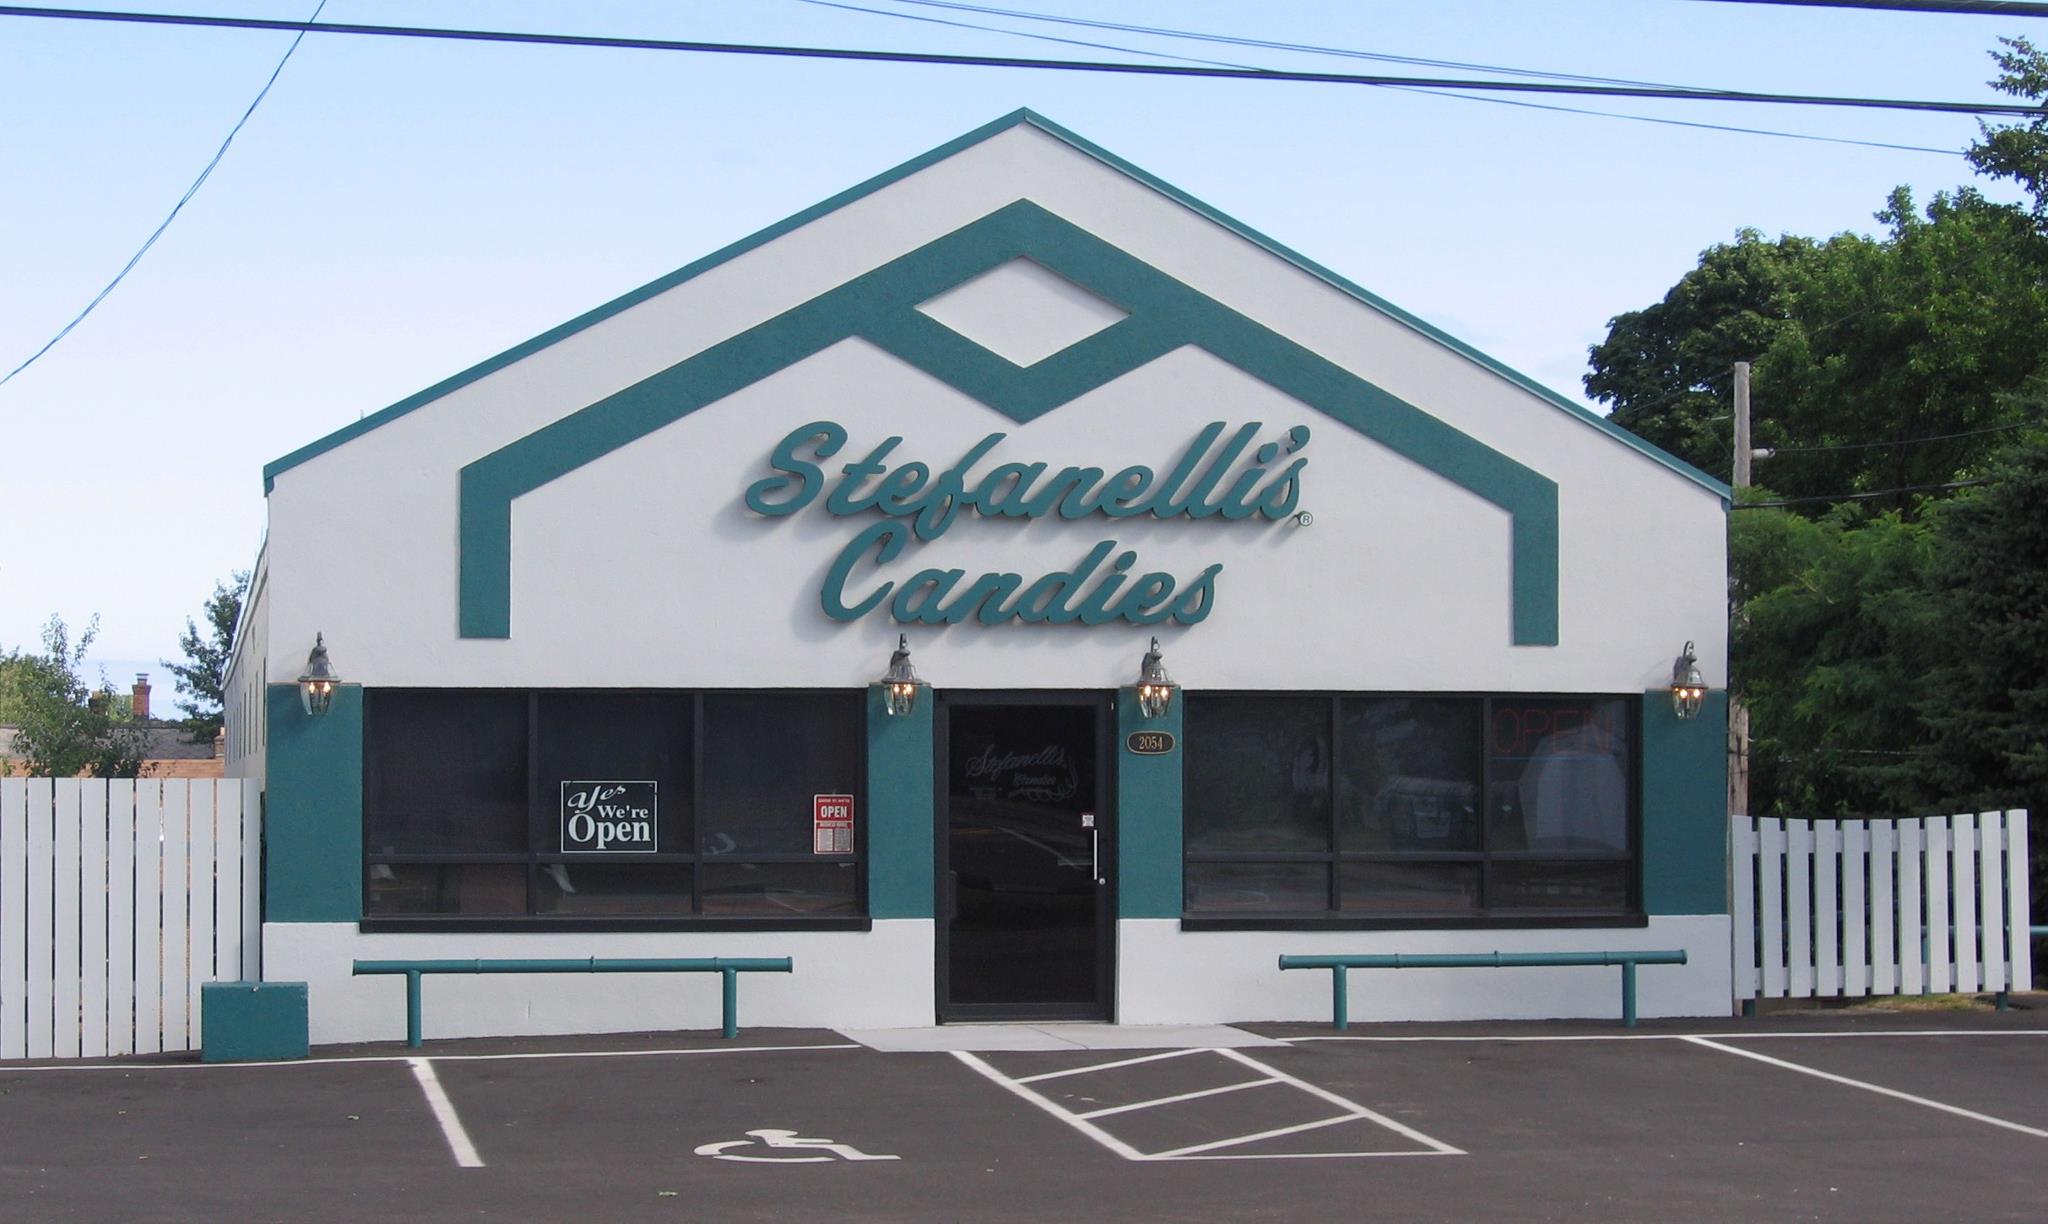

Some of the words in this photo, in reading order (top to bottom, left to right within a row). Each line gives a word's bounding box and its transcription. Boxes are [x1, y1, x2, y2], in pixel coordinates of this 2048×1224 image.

[745, 421, 1309, 541] Stefanelli's
[821, 520, 1222, 625] Candies
[1139, 736, 1163, 750] 2054
[1492, 707, 1612, 754] OPEN
[567, 785, 626, 814] Yes
[597, 805, 649, 819] We're
[821, 805, 848, 818] OPEN
[568, 813, 651, 850] Open
